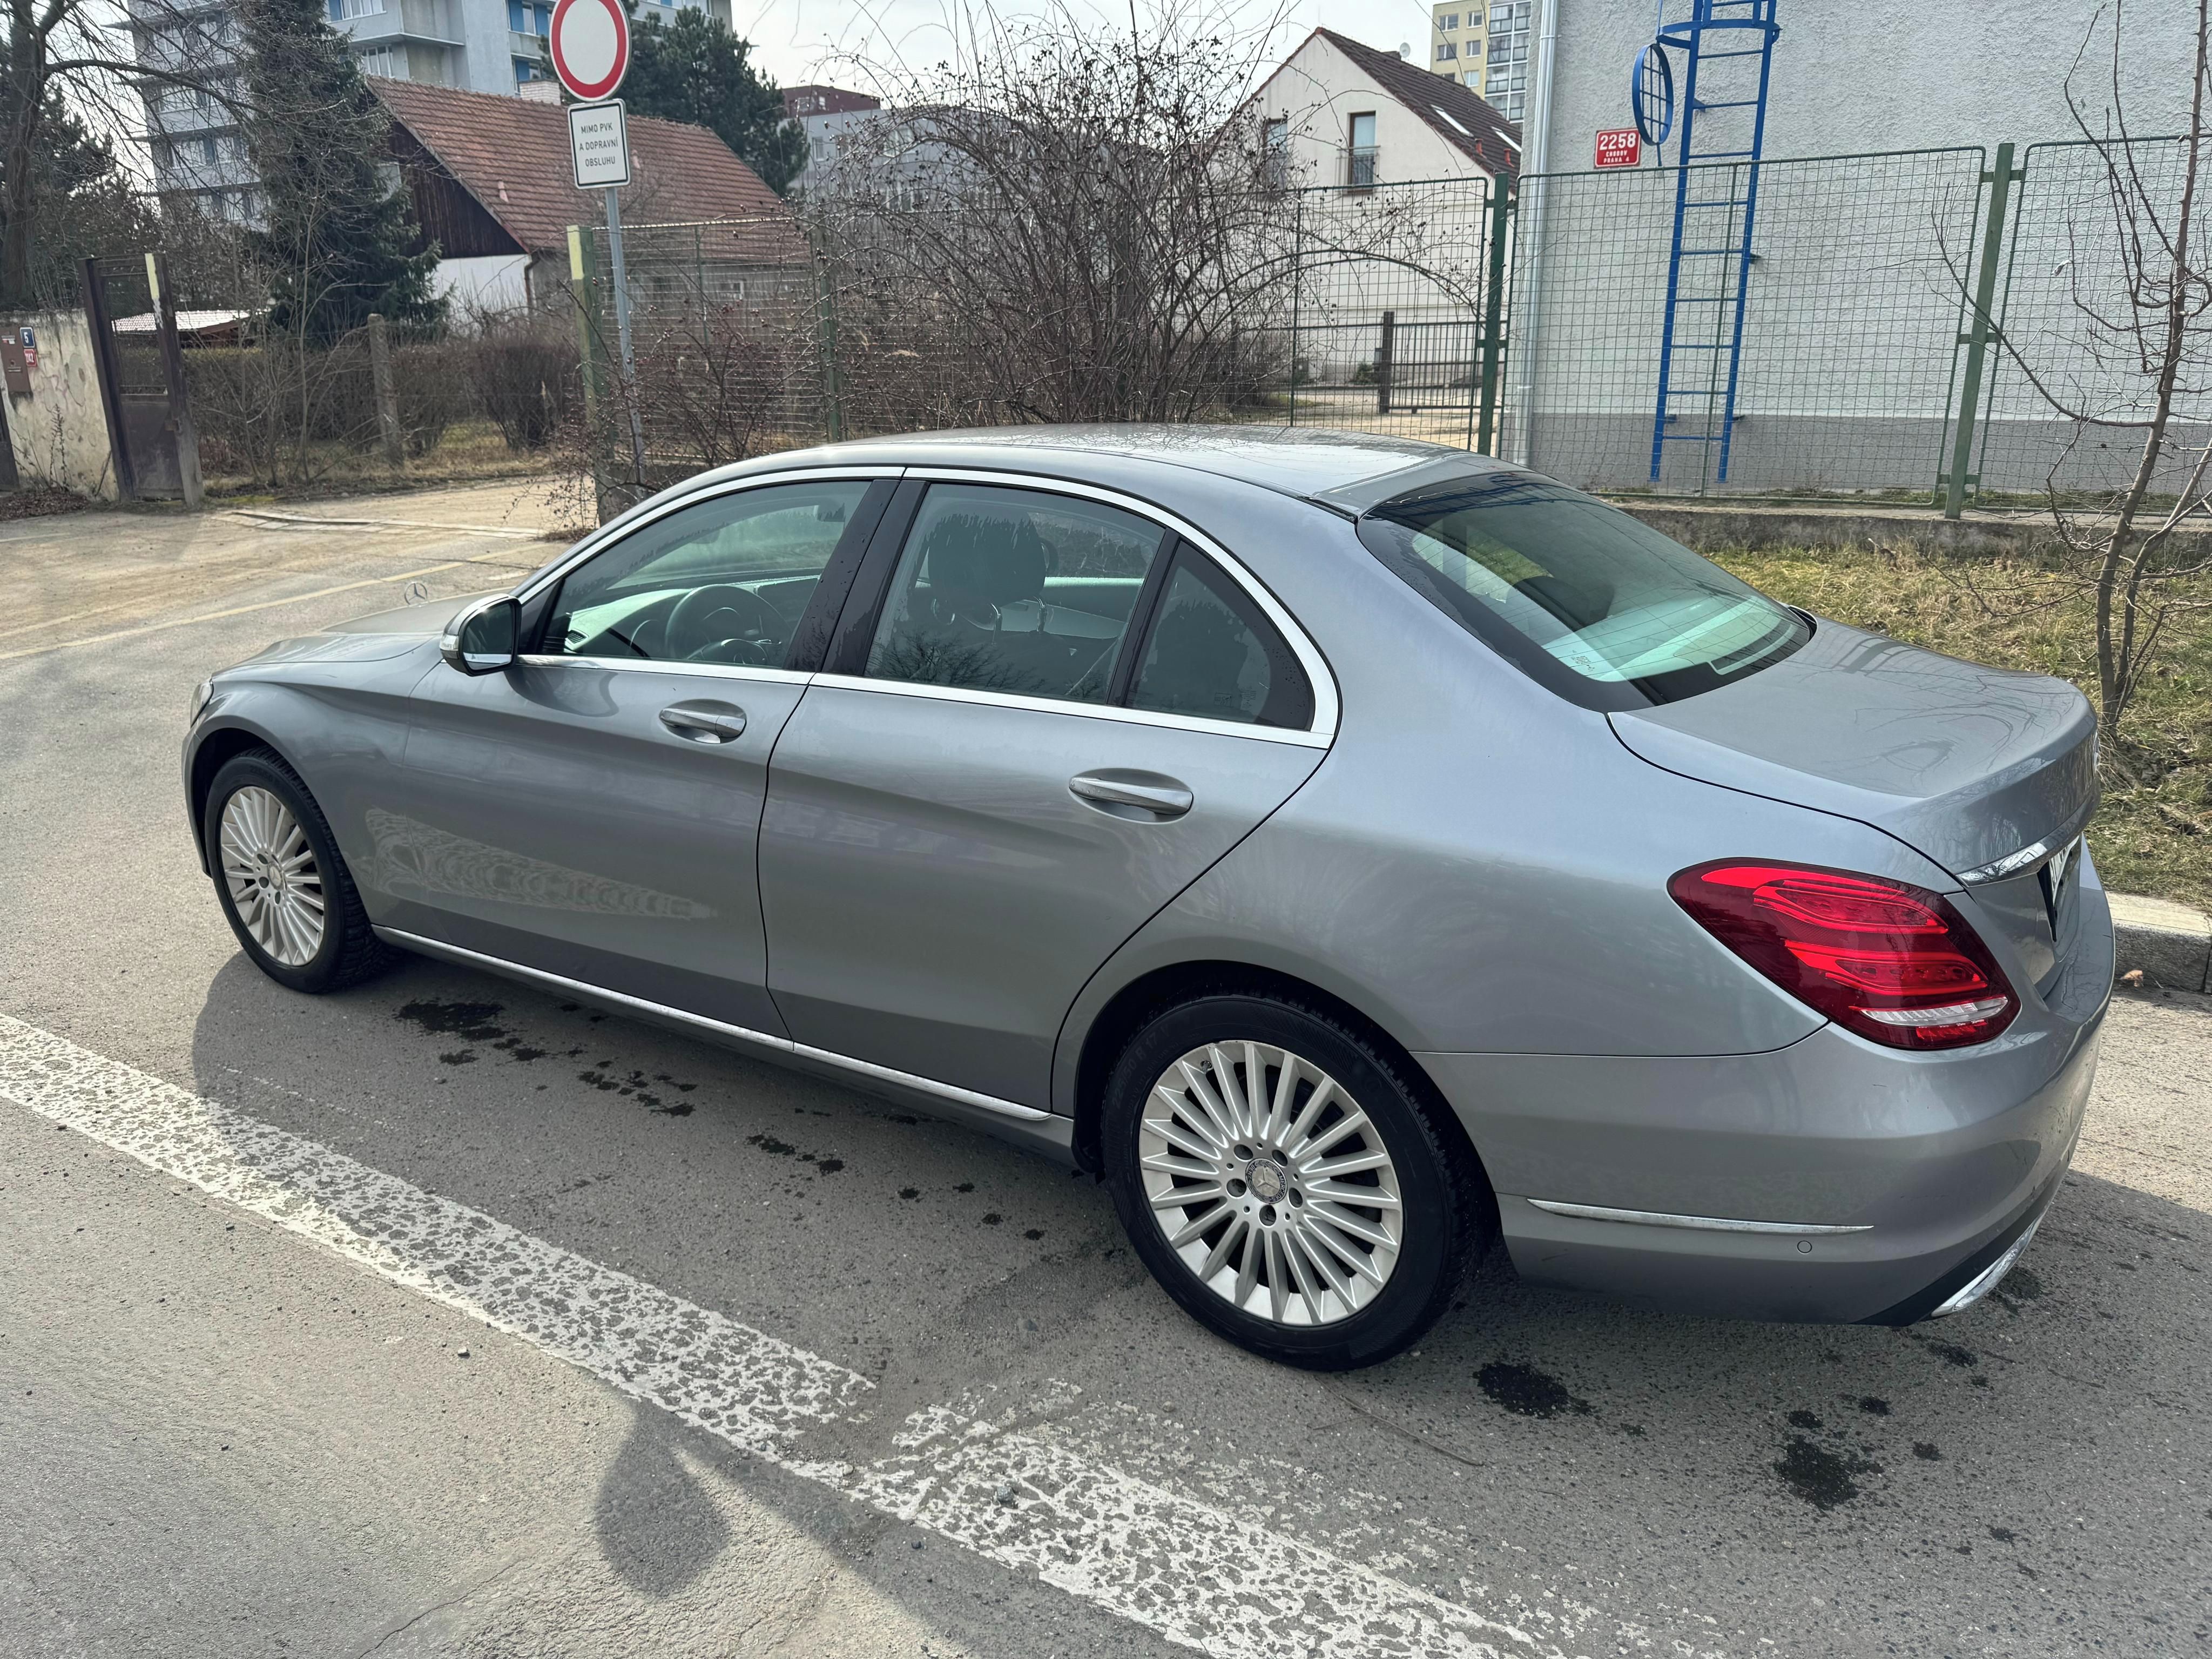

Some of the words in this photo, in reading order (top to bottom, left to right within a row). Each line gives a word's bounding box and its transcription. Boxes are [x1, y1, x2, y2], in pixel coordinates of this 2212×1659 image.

[581, 124, 598, 134] MIMO
[600, 123, 613, 132] PVK
[585, 137, 618, 150] DOPRAVNÍ
[1600, 133, 1636, 150] 2258
[585, 156, 616, 167] OBSLUHU
[24, 332, 29, 343] 5
